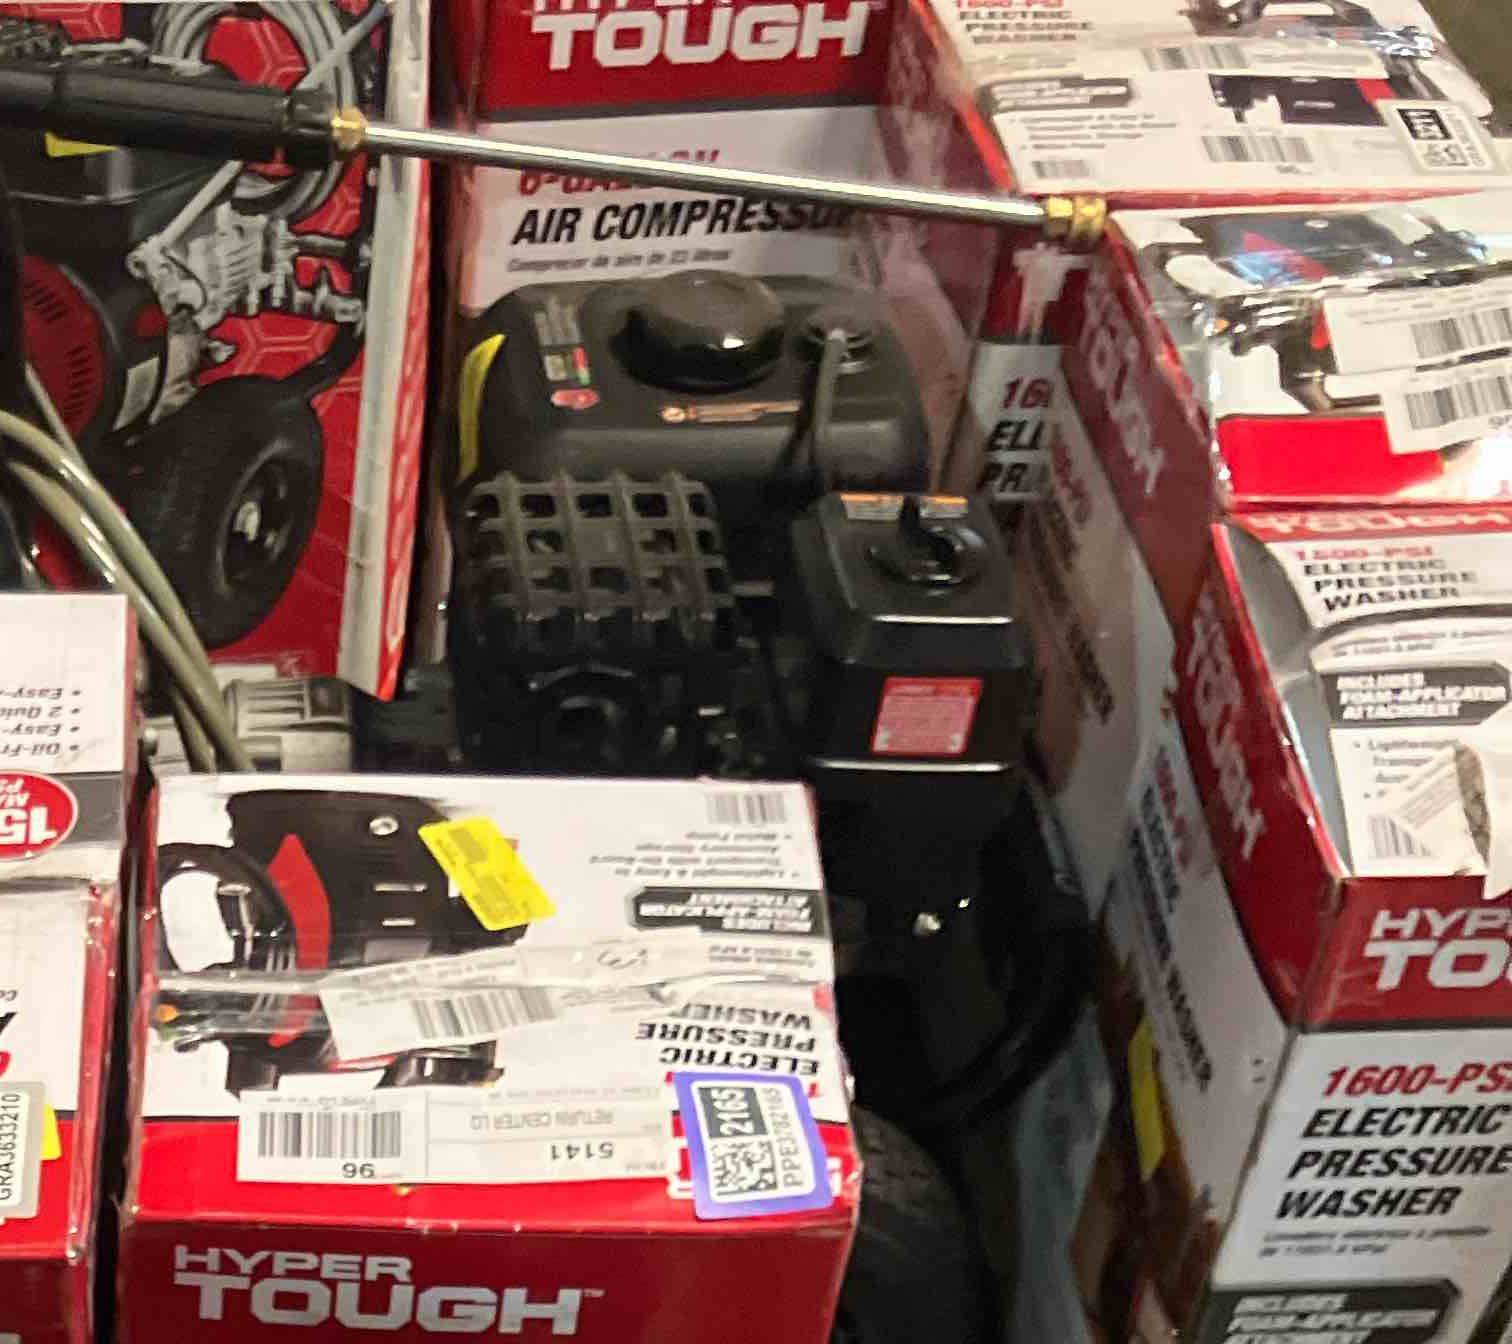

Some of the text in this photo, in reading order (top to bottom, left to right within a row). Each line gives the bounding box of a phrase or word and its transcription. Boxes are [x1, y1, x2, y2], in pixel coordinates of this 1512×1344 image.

[531, 2, 872, 72] TOUGH
[511, 207, 583, 245] AIR
[1304, 558, 1447, 577] ELECTRIC
[1314, 571, 1478, 593] PRESSURE
[1324, 586, 1461, 613] WASHER
[1369, 907, 1512, 939] HYP
[635, 1021, 817, 1052] PRESSURE
[658, 1046, 821, 1078] ELECTRIC
[710, 1088, 754, 1137] 2165
[1300, 1103, 1512, 1139] ELECTRIC
[549, 1141, 615, 1161] 5141
[1286, 1145, 1512, 1180] PRESSURE
[341, 1163, 375, 1179] 96
[1275, 1185, 1463, 1219] WASHER
[173, 1244, 414, 1283] HYPER
[173, 1271, 583, 1335] TOUGH
